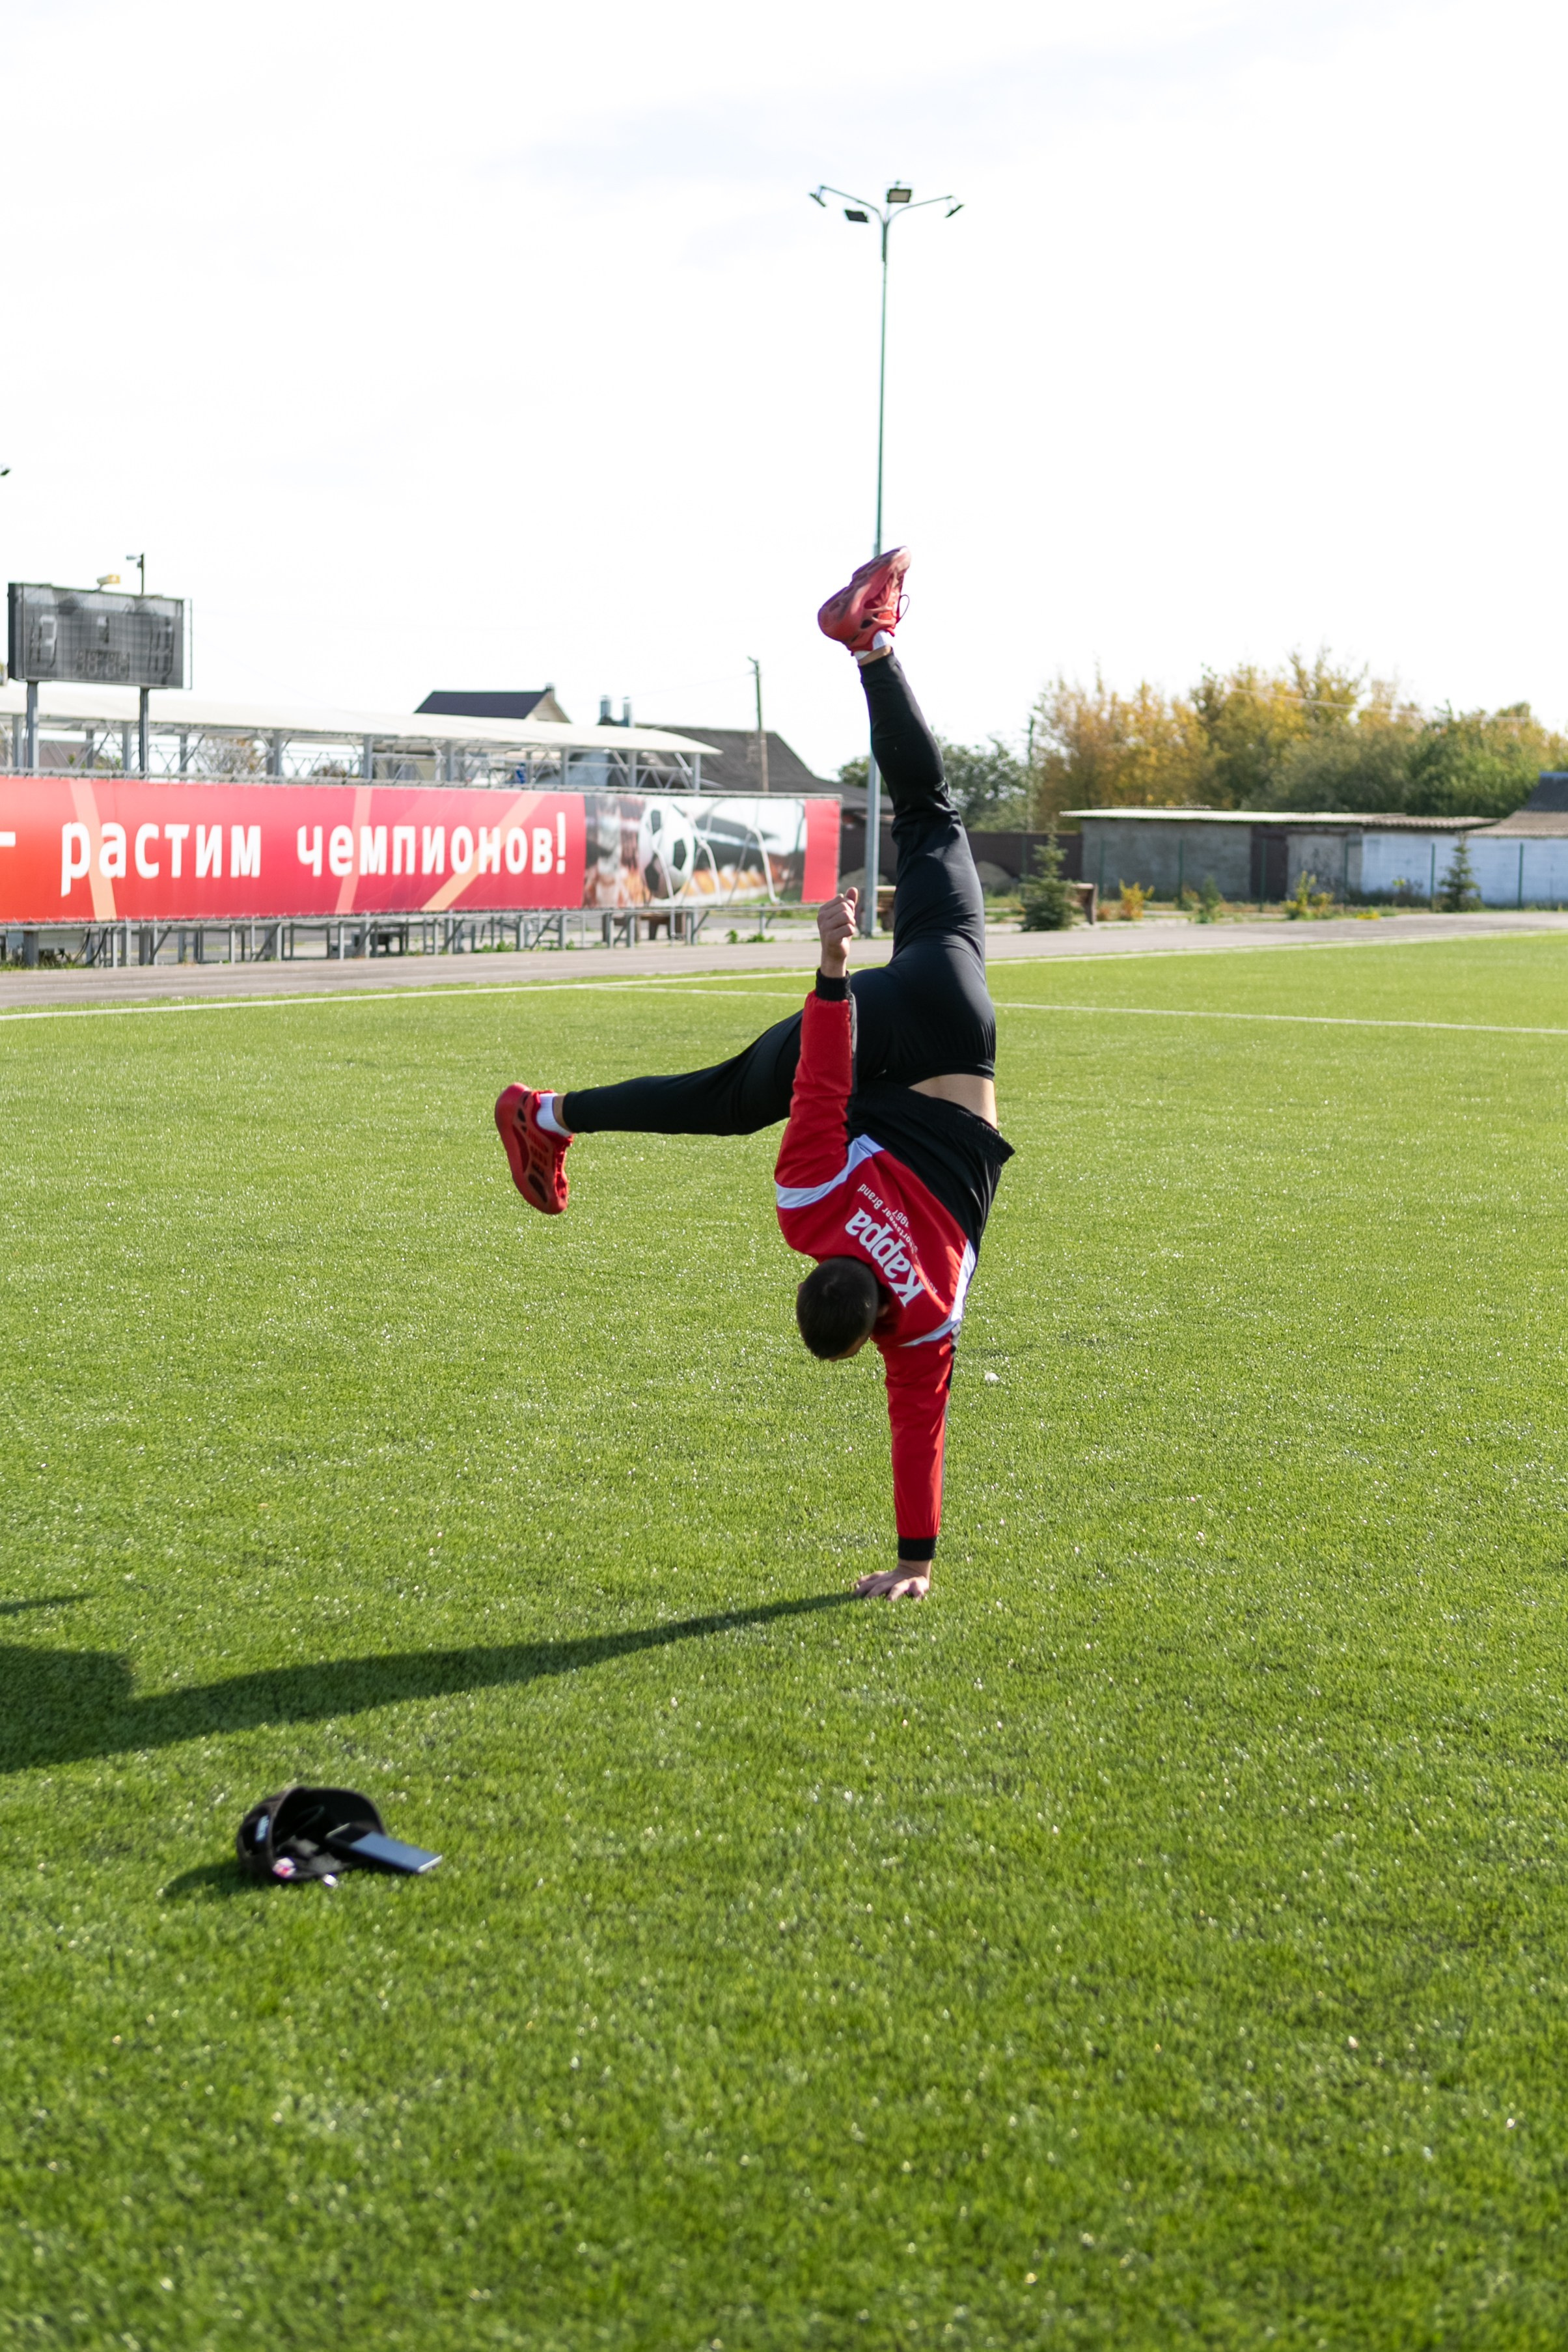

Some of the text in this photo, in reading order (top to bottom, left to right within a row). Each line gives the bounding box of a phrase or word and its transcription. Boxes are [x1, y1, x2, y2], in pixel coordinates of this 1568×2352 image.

[61, 822, 261, 897] растим
[297, 812, 566, 877] чемпионов!
[857, 1183, 883, 1210] Brand
[892, 1210, 909, 1228] 1967
[845, 1208, 926, 1307] Kappa
